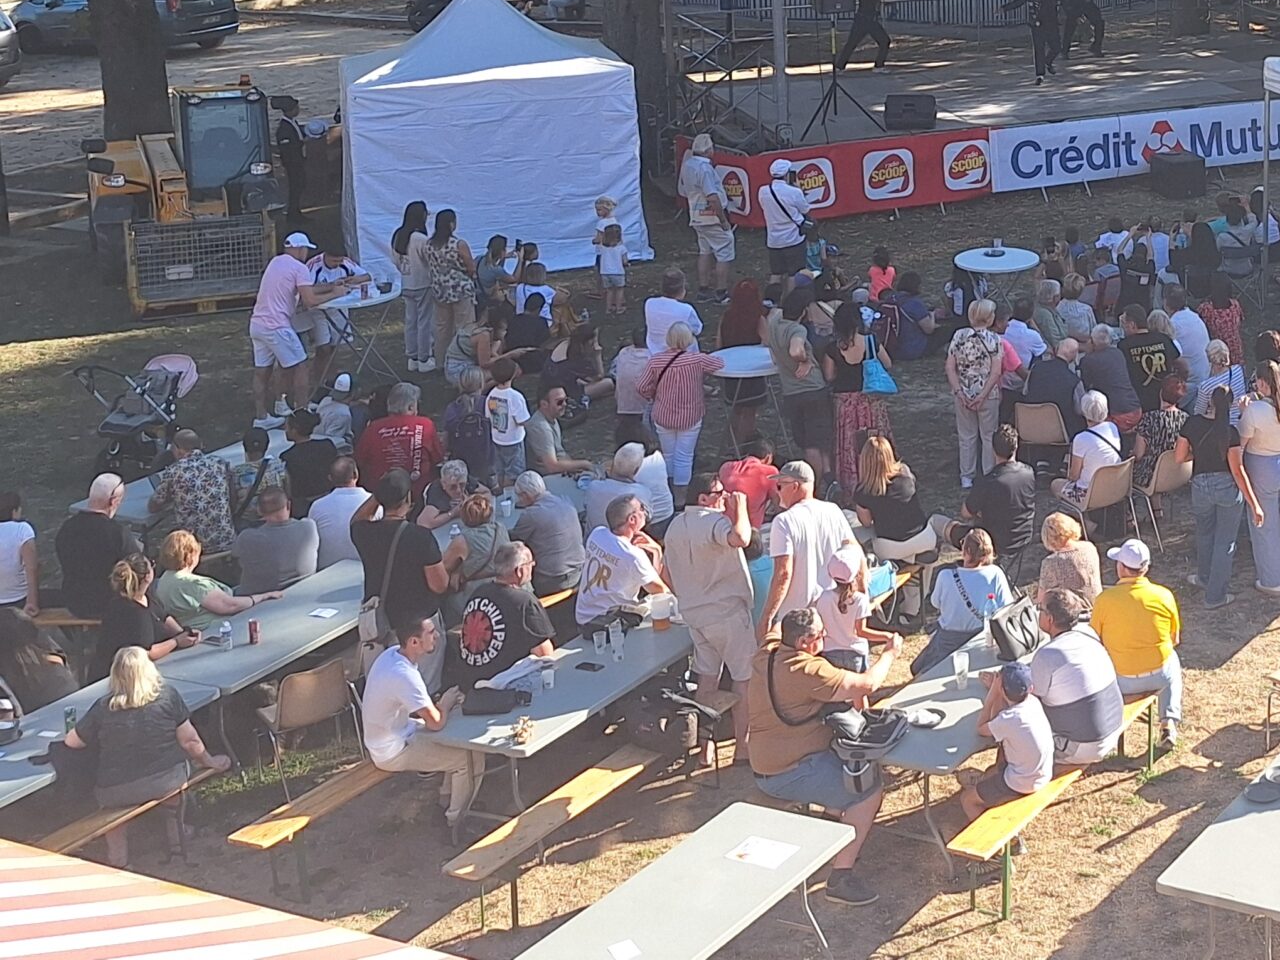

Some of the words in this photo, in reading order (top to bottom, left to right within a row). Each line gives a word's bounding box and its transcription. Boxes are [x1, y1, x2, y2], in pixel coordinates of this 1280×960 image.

[951, 155, 985, 173] SCOOP
[1010, 131, 1138, 179] Crédit
[798, 174, 826, 190] COOP
[871, 164, 906, 182] SCOOP
[1130, 343, 1165, 355] SEPTEMBRE
[460, 631, 506, 667] PEPPERS
